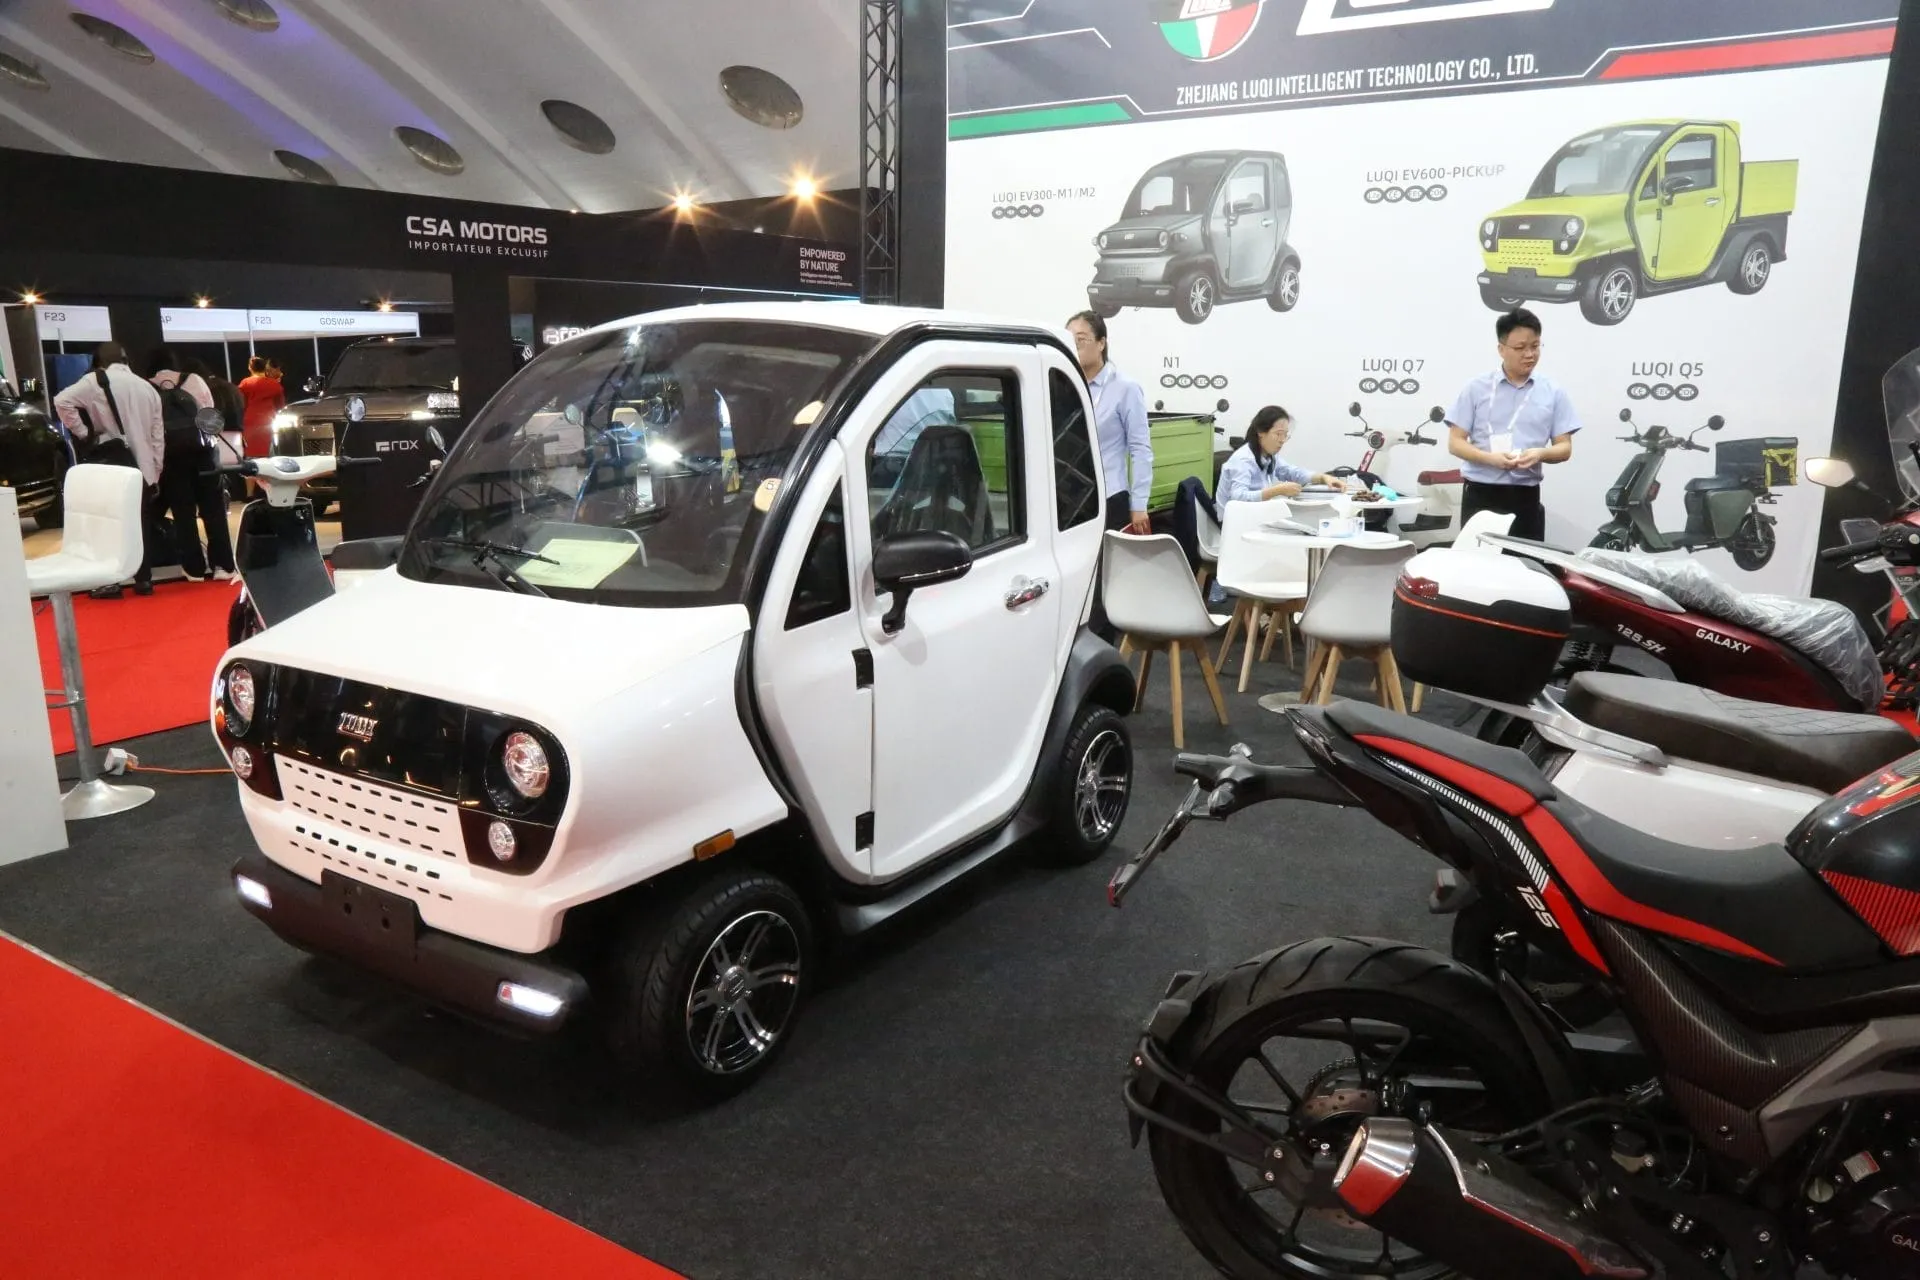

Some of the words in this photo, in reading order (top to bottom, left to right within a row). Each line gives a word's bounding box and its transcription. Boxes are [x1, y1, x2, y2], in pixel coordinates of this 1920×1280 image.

[1176, 81, 1238, 105] ZHEJIANG
[1243, 78, 1273, 99] LUQI
[1276, 69, 1364, 96] INTELLIGENT
[1368, 60, 1465, 87] TECHNOLOGY
[1469, 57, 1501, 80] CO.,
[1507, 53, 1540, 76] LTD.
[1367, 170, 1398, 183] LUQI
[1402, 164, 1505, 181] EV600-PICKUP
[993, 191, 1017, 203] LUQI
[1020, 187, 1096, 201] EV300-M1/M2
[406, 215, 455, 238] CSA
[460, 221, 548, 245] MOTORS
[409, 240, 492, 255] IMPORTATEUR
[497, 246, 549, 258] EXCLUSIF
[800, 247, 846, 261] EMPOWERED
[800, 259, 810, 270] BY
[810, 260, 839, 273] NATURE
[44, 312, 66, 322] F23
[254, 316, 272, 325] F23
[319, 317, 355, 326] GOSWAP
[1163, 356, 1180, 369] N1
[1362, 358, 1398, 374] LUQI
[1402, 358, 1425, 375] Q7
[1631, 361, 1674, 379] LUQI
[1679, 361, 1704, 379] Q5
[1616, 623, 1643, 643] 125
[1641, 639, 1667, 653] SH
[1695, 628, 1752, 654] GALAXY
[1516, 886, 1560, 929] 125
[1891, 1234, 1920, 1252] GAL
